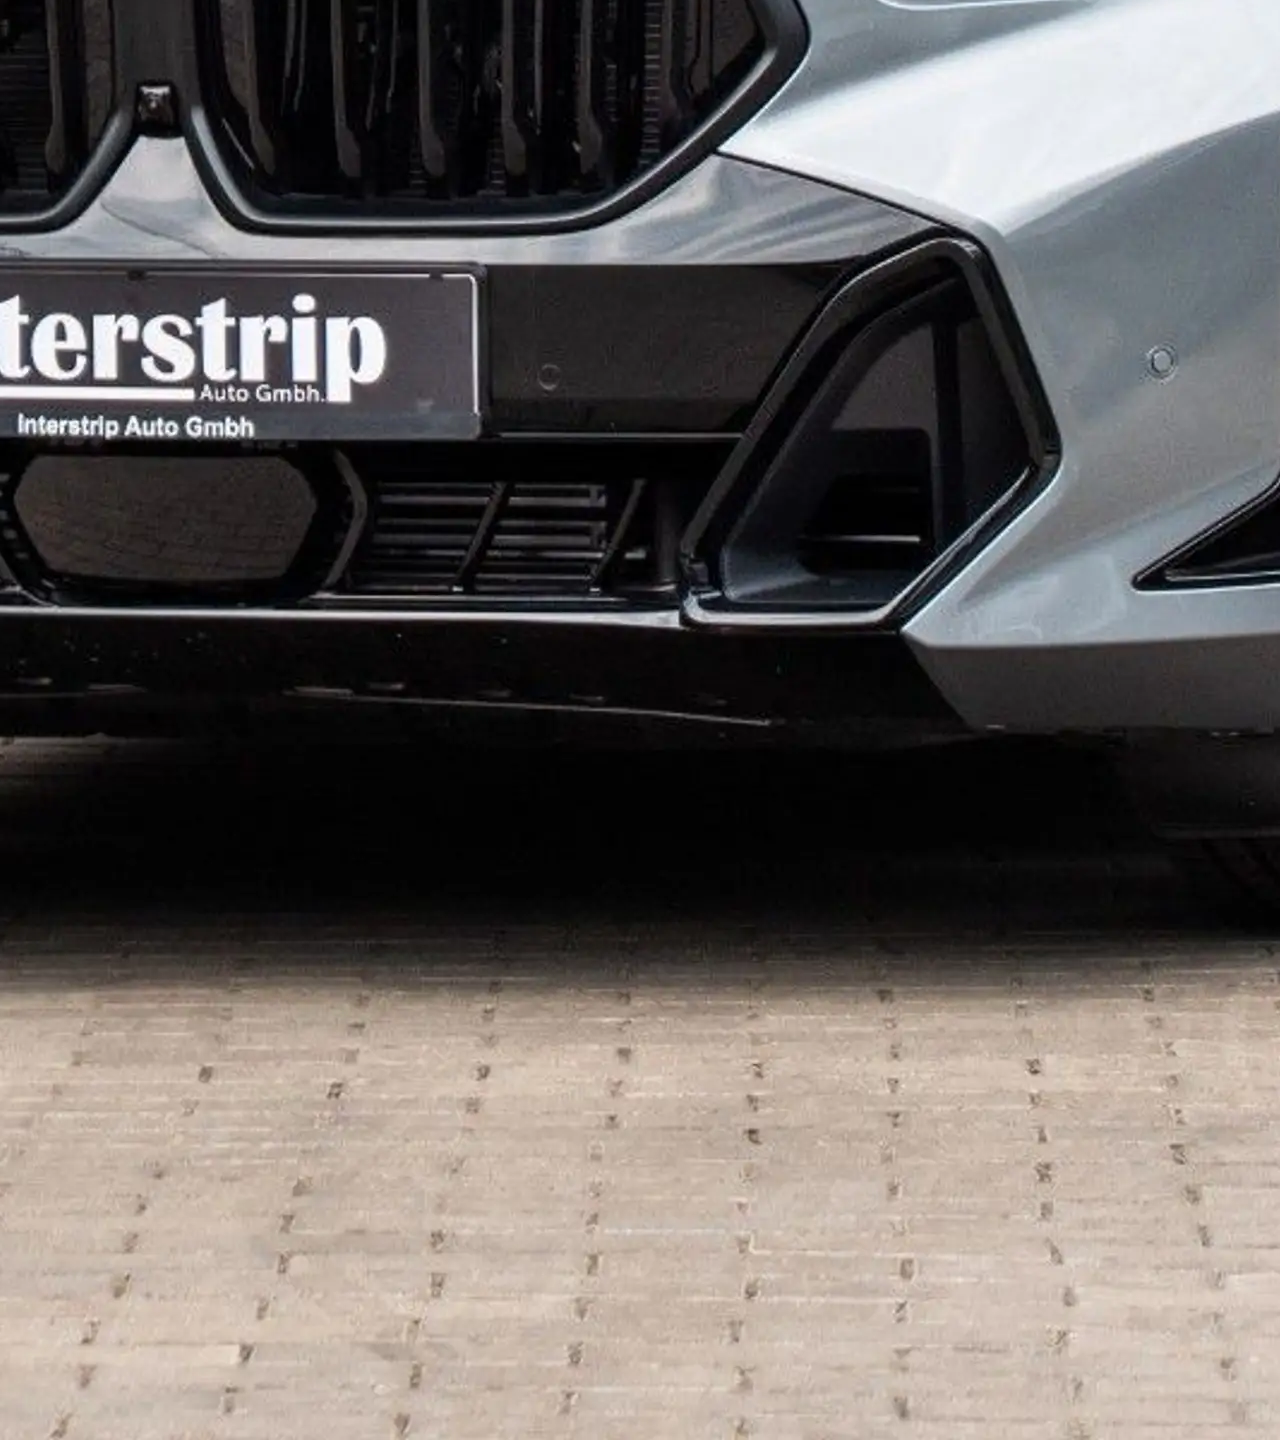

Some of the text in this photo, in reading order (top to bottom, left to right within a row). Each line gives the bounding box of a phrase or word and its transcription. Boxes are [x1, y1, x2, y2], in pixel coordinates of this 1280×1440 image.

[200, 383, 250, 402] Auto
[17, 413, 255, 439] Interstrip Auto Gmbh
